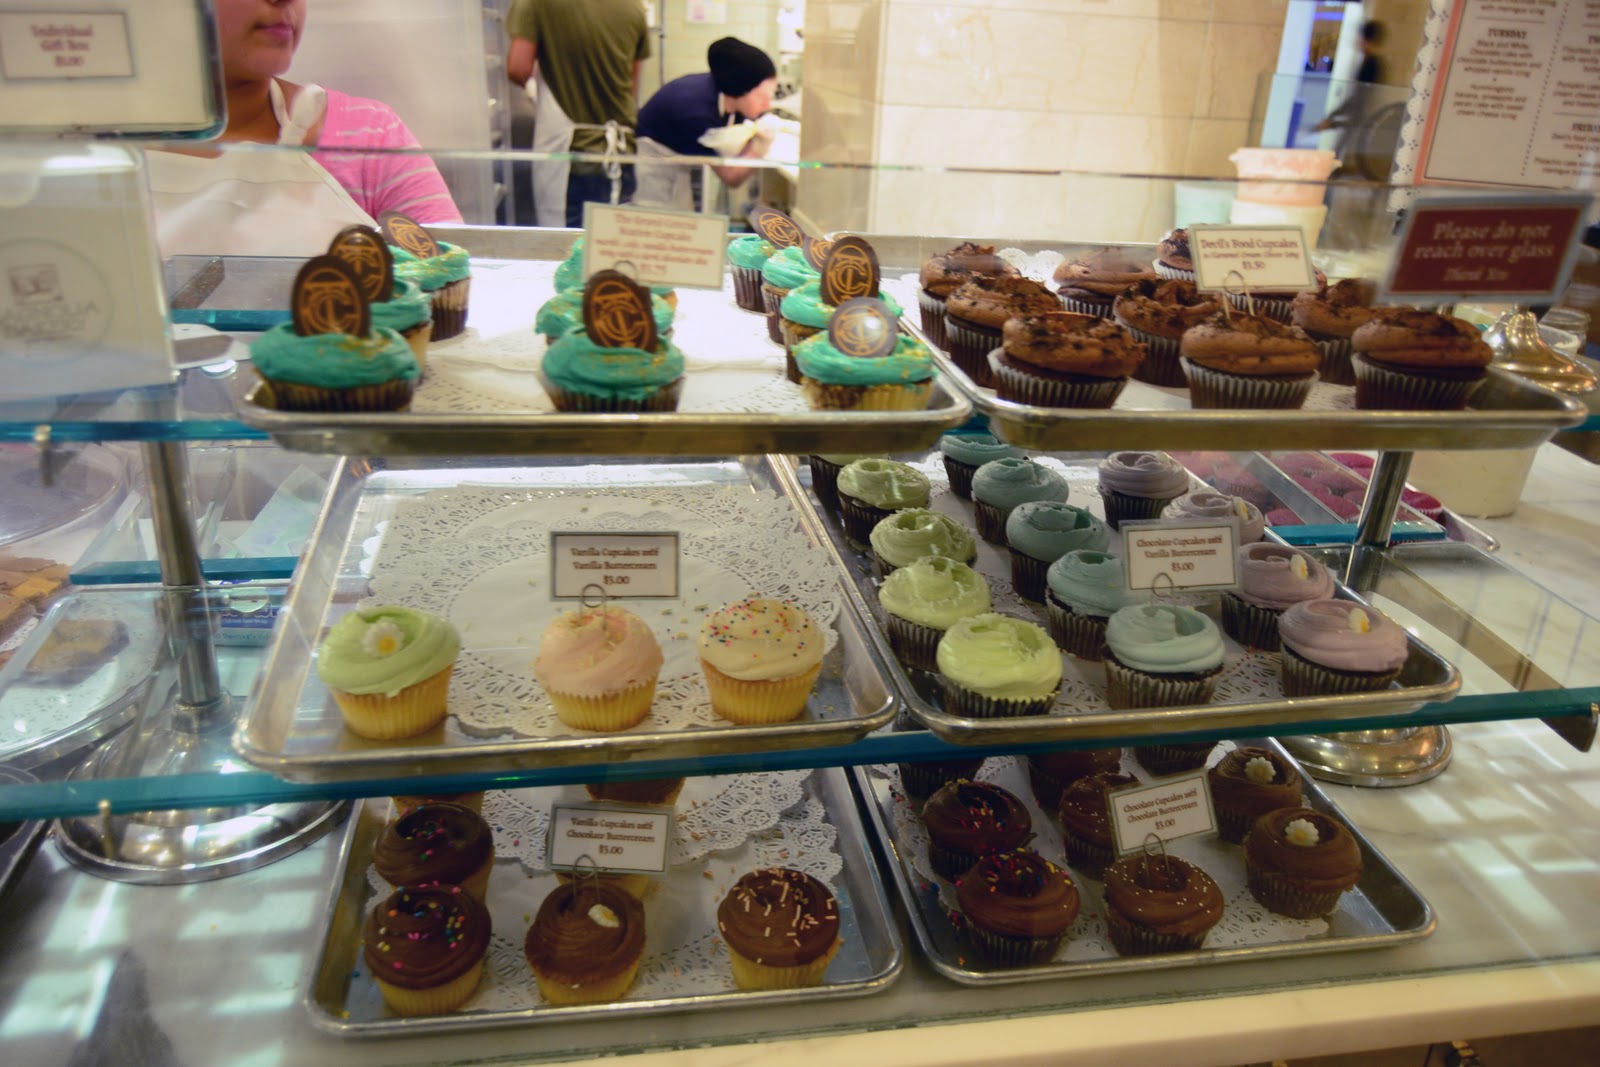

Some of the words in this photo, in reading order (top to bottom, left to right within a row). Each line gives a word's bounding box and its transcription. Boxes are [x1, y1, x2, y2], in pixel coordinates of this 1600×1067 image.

[1433, 221, 1490, 240] Please
[1492, 220, 1515, 239] do
[1519, 223, 1552, 239] not
[1231, 238, 1256, 249] Food
[1256, 237, 1298, 252] Cupcakes
[1413, 241, 1464, 259] reach
[1467, 246, 1508, 259] over
[1507, 240, 1554, 263] glass
[1137, 538, 1172, 548] Chocolate
[1173, 536, 1206, 548] Cupcakes
[570, 547, 600, 556] Vanilla
[601, 547, 640, 559] Cupcakes
[1144, 549, 1170, 558] Vanilla
[1171, 549, 1216, 557] Buttercream
[573, 560, 602, 570] Vanilla
[604, 561, 657, 570] Buttercream
[1123, 800, 1155, 813] Chocolate
[1155, 793, 1184, 806] Cupcakes
[1127, 810, 1158, 823] Chocolate
[1158, 801, 1199, 815] Buttercream
[571, 817, 598, 826] Vanilla
[600, 819, 635, 830] Cupcakes
[1155, 818, 1176, 830] $3.00
[567, 829, 604, 840] Chocolate
[606, 832, 656, 842] Buttercream
[599, 844, 624, 855] $3.00
